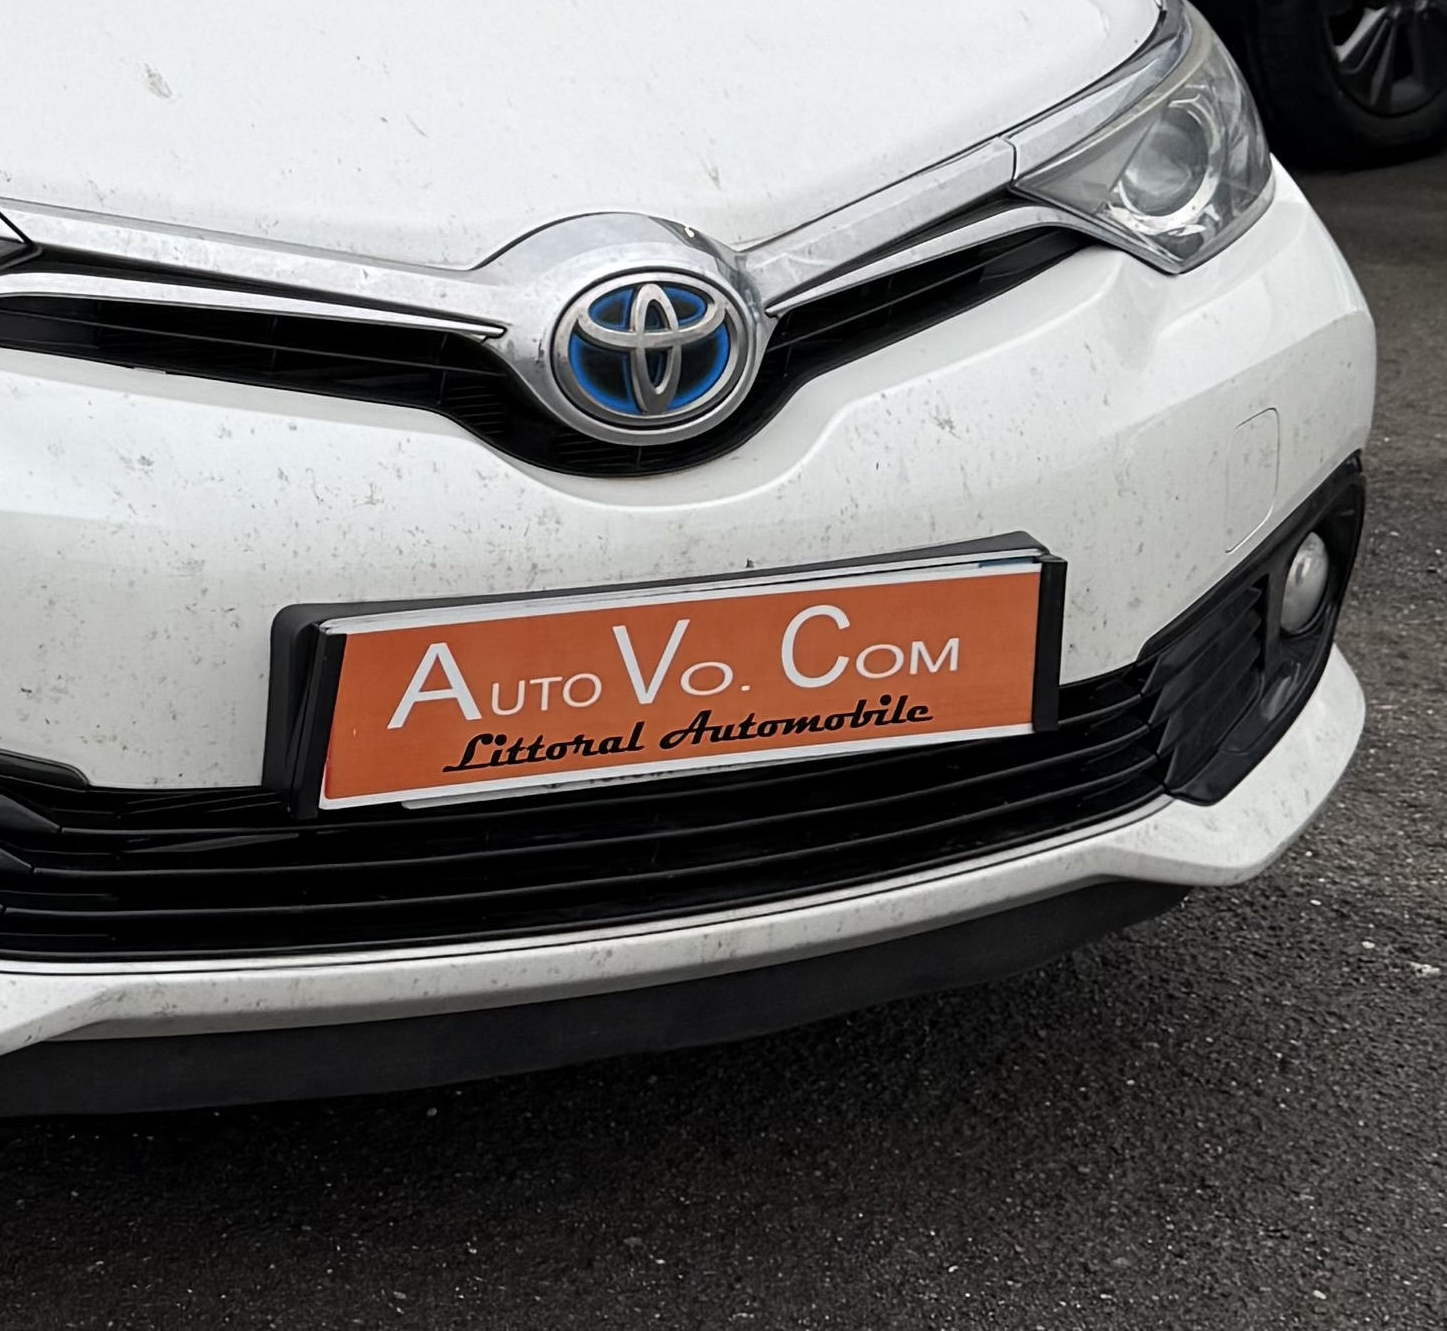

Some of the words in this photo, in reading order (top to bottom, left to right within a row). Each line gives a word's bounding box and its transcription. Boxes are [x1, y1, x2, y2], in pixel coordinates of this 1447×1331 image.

[386, 642, 602, 730] AUTO
[781, 604, 960, 688] COM
[442, 720, 645, 773] Littoral
[659, 694, 934, 750] Automobile
